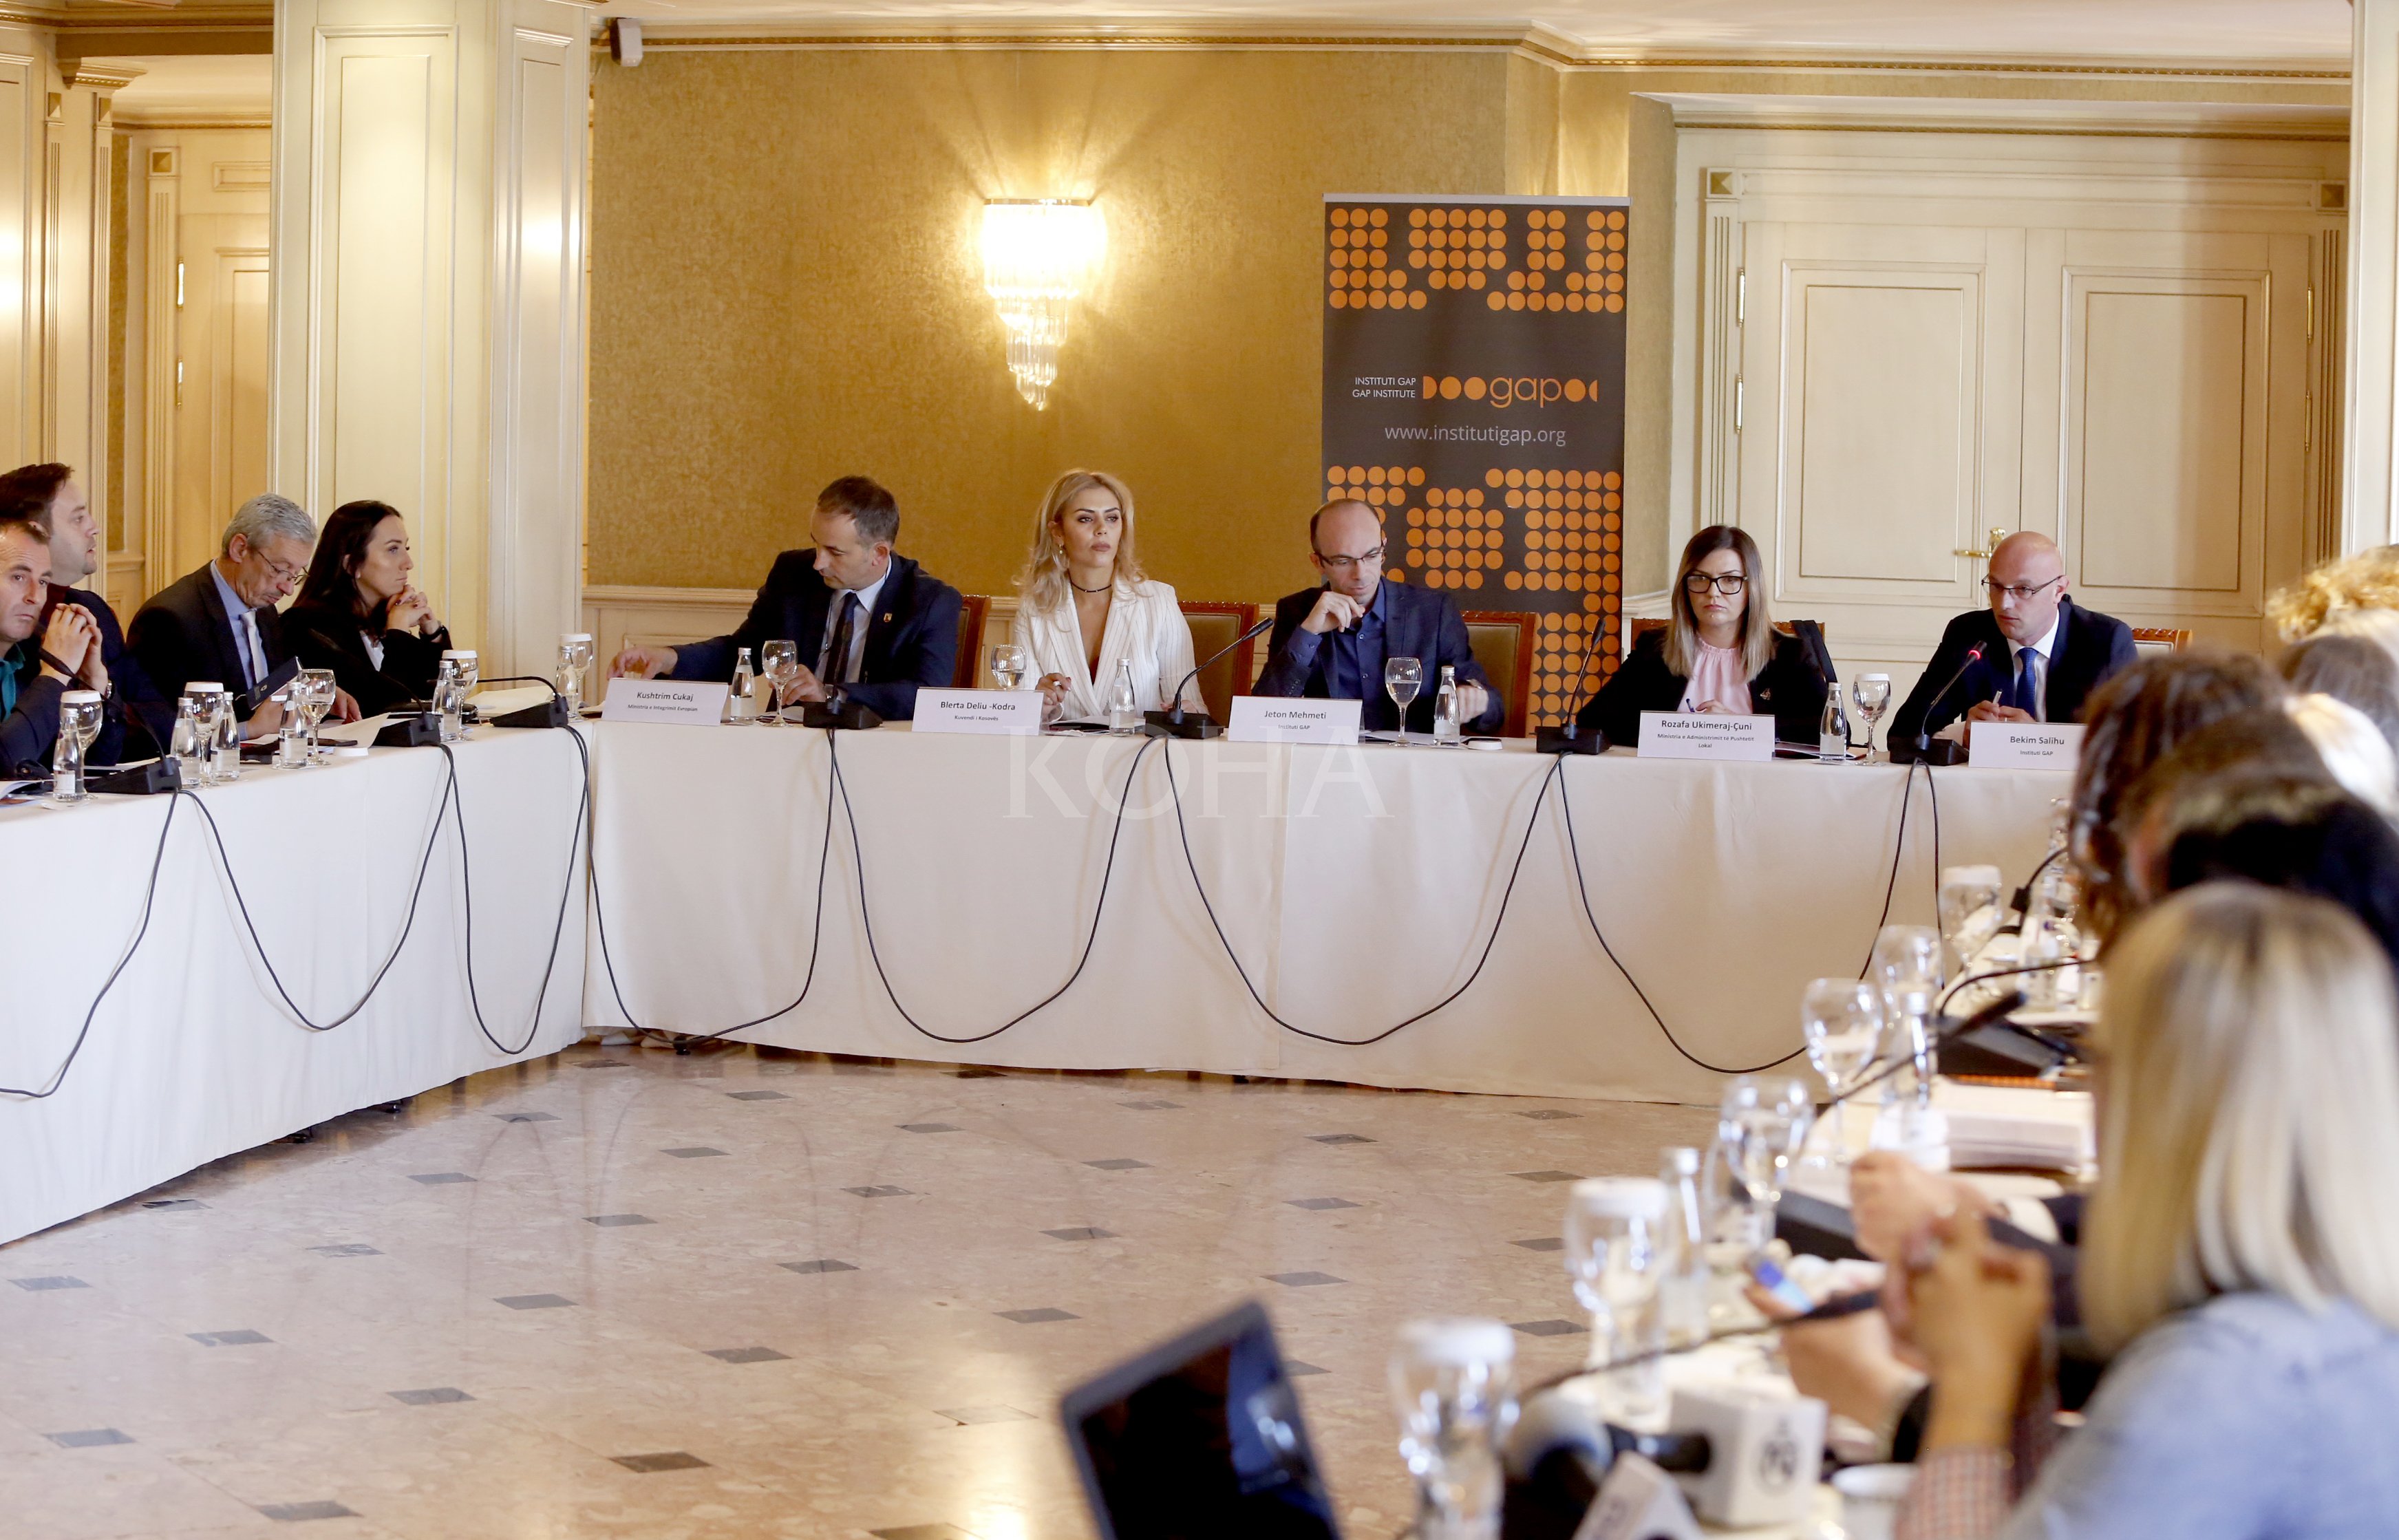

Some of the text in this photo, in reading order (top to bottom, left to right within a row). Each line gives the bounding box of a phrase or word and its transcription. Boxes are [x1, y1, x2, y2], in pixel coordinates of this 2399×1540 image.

[1355, 376, 1416, 386] INSTITUTI GAP
[1352, 389, 1416, 398] GAP INSTITUTE
[1490, 376, 1563, 408] gap
[1385, 425, 1566, 447] www.institutigap.org
[637, 692, 694, 702] Kushtrim Cukaj
[1662, 720, 1752, 731] Rozafa Ukimeraj-Çuni
